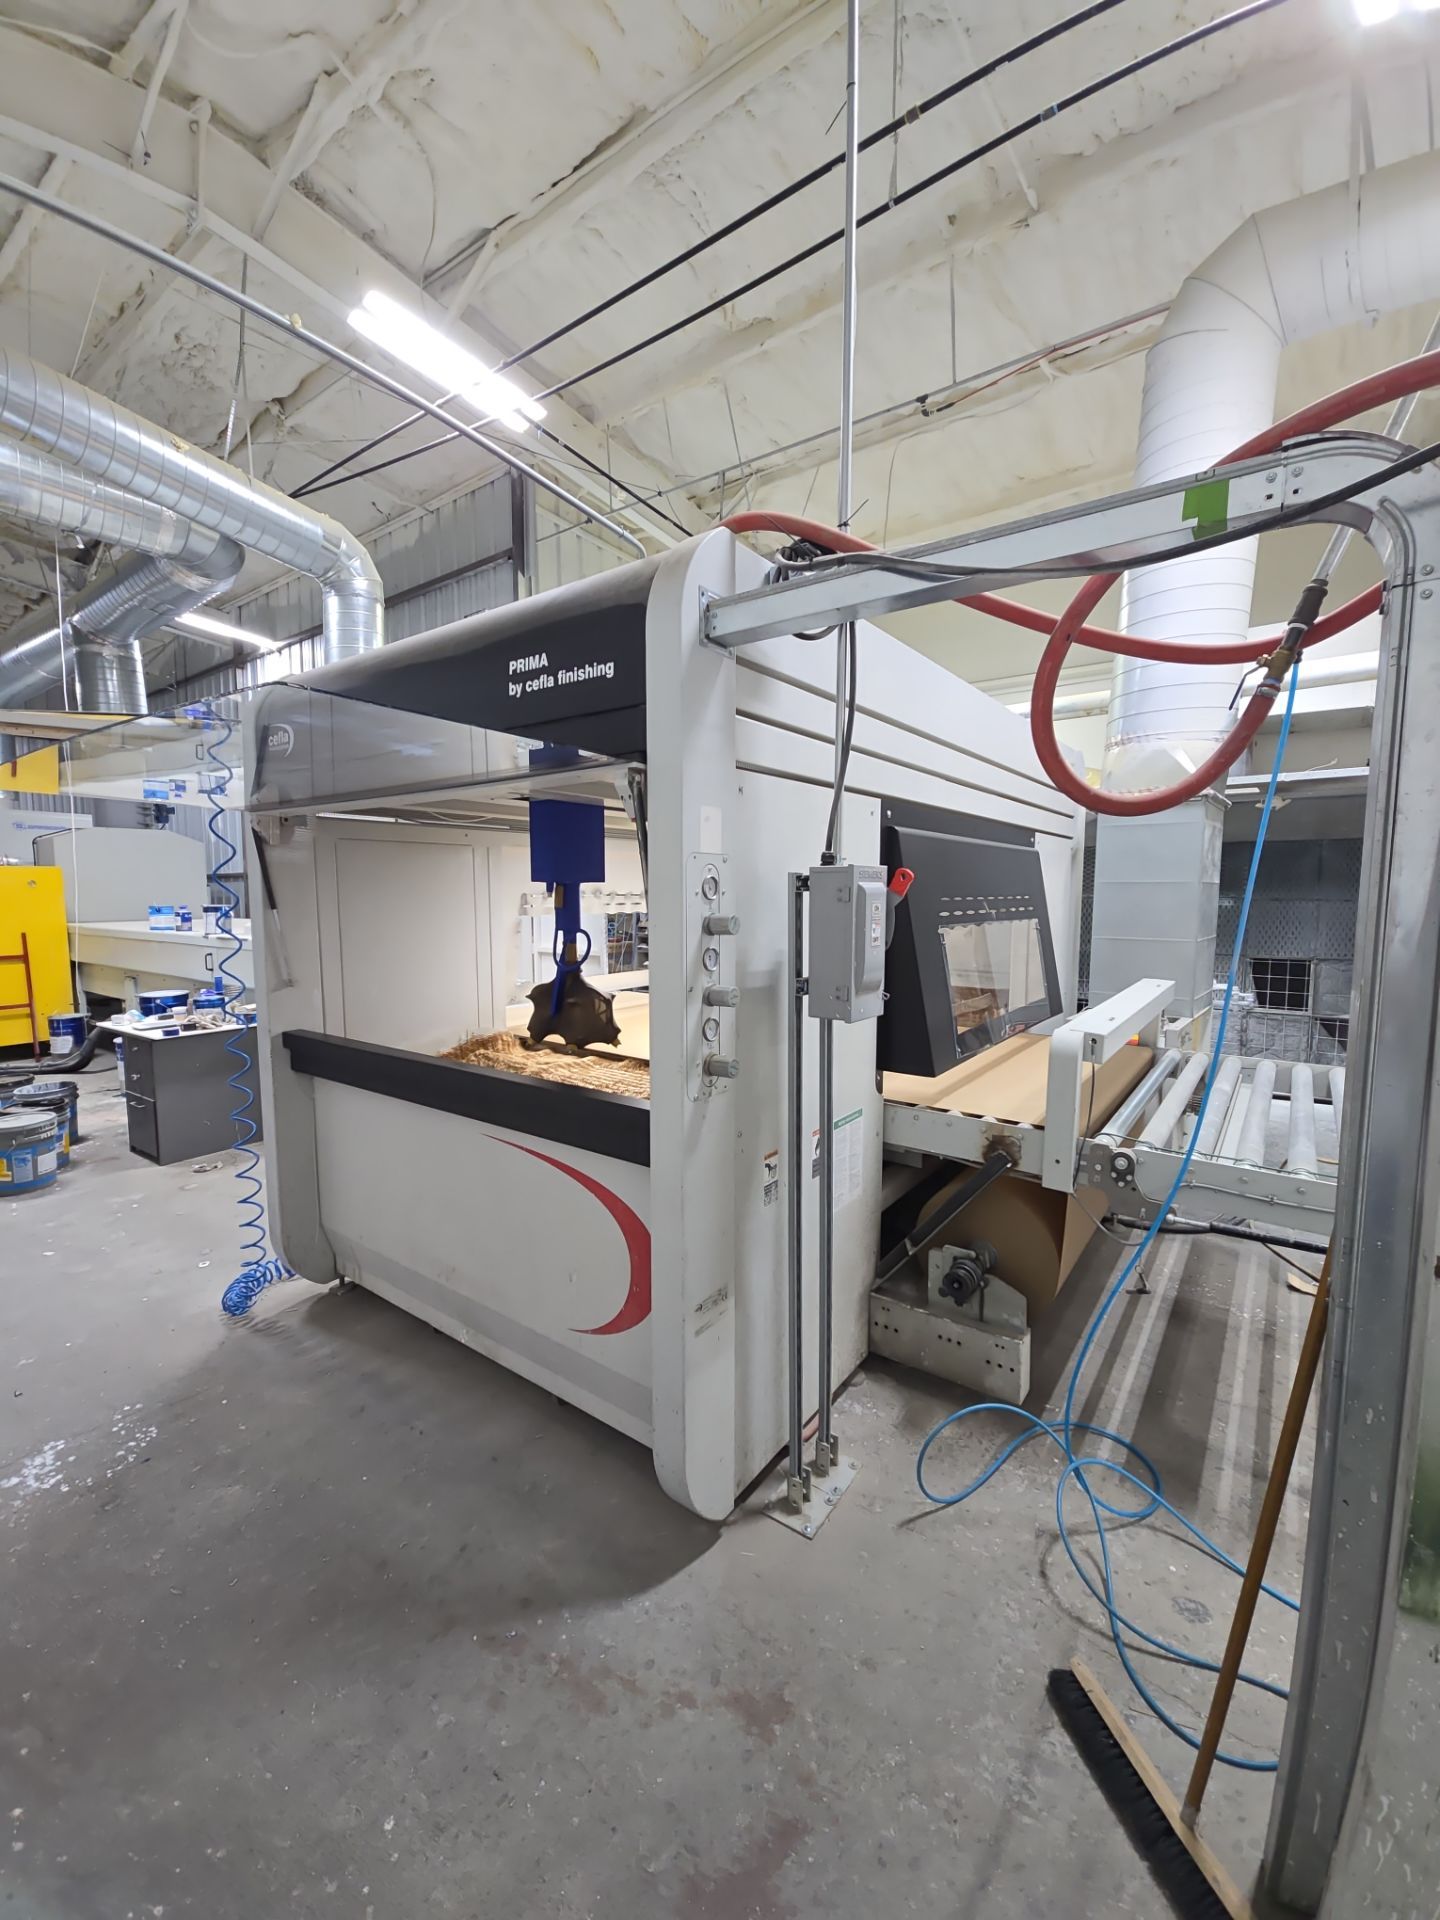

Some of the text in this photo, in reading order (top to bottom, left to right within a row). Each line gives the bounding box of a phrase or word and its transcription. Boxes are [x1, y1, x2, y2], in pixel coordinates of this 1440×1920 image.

[509, 653, 548, 675] PRIMA
[508, 662, 614, 698] by cefla finishing
